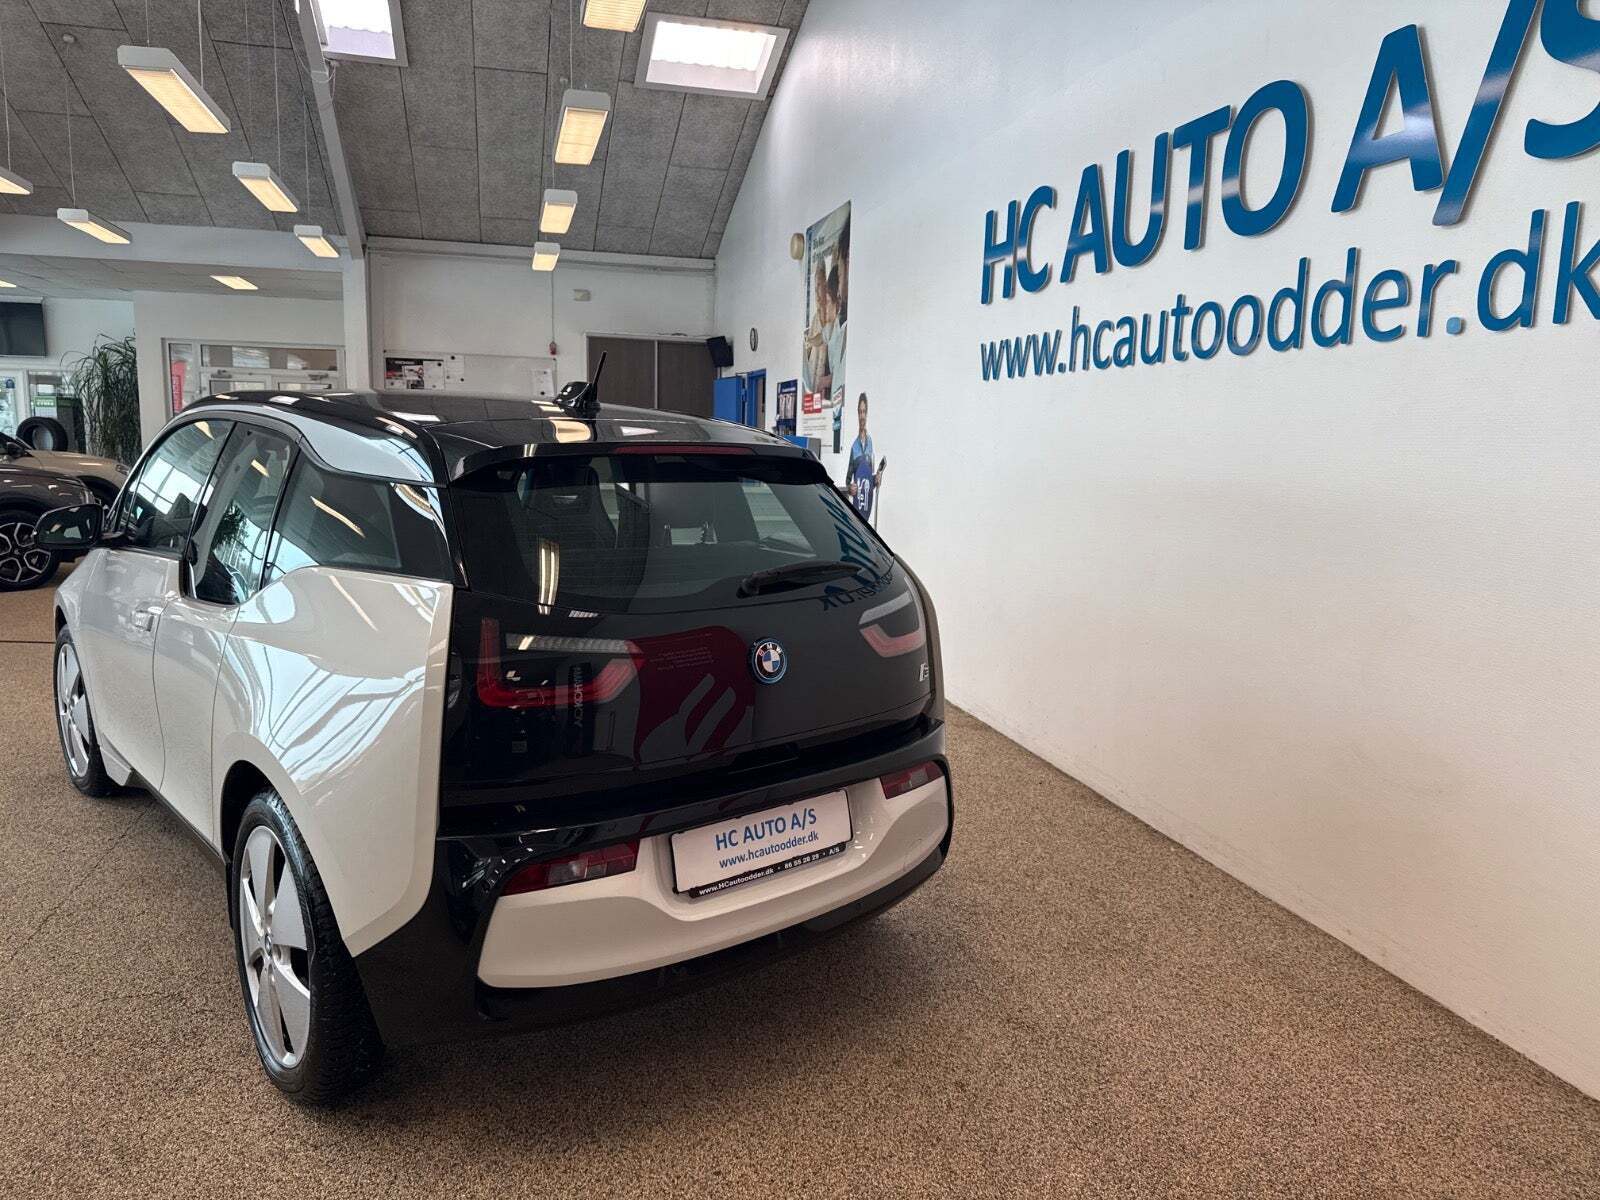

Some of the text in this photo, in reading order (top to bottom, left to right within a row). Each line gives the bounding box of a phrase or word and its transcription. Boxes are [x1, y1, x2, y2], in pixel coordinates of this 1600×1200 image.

[981, 185, 1056, 305] HC
[1060, 79, 1309, 283] AUTO
[980, 201, 1600, 381] www.hcautoodder.dk
[715, 808, 817, 851] HC AUTO A/S
[719, 831, 819, 868] www.hcautoodder.dk
